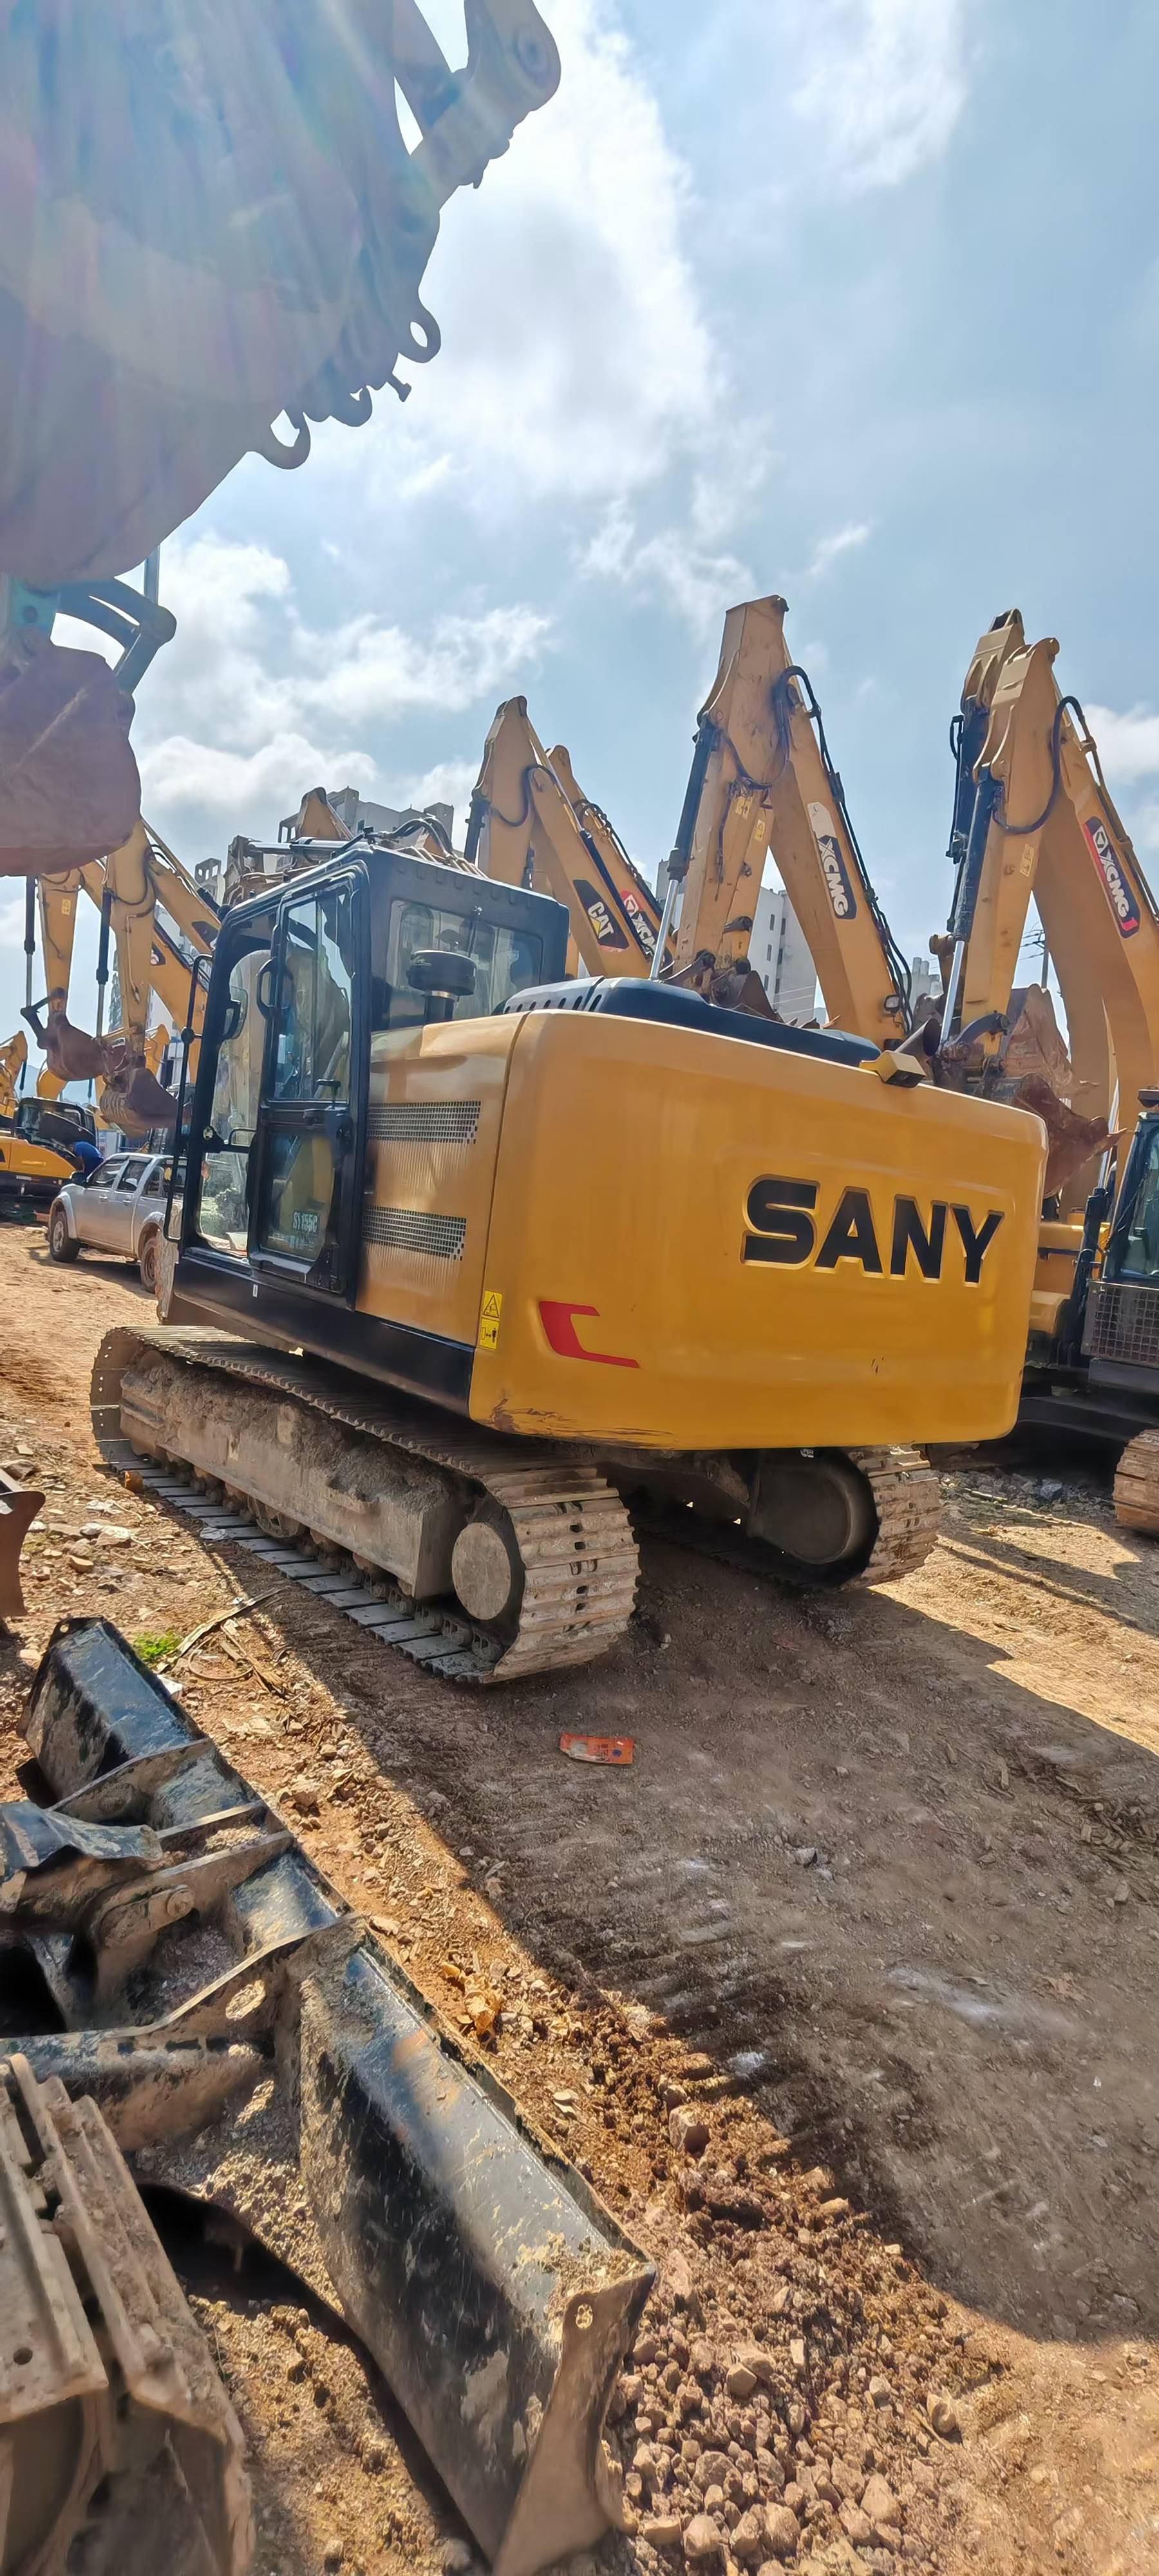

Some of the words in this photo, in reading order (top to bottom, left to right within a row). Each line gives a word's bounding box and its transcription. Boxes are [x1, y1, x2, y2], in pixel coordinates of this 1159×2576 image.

[818, 838, 848, 916] XCMG
[1099, 849, 1129, 917] XCMG
[588, 902, 614, 939] CAT
[632, 913, 662, 960] XCM
[742, 1176, 1004, 1285] SANY
